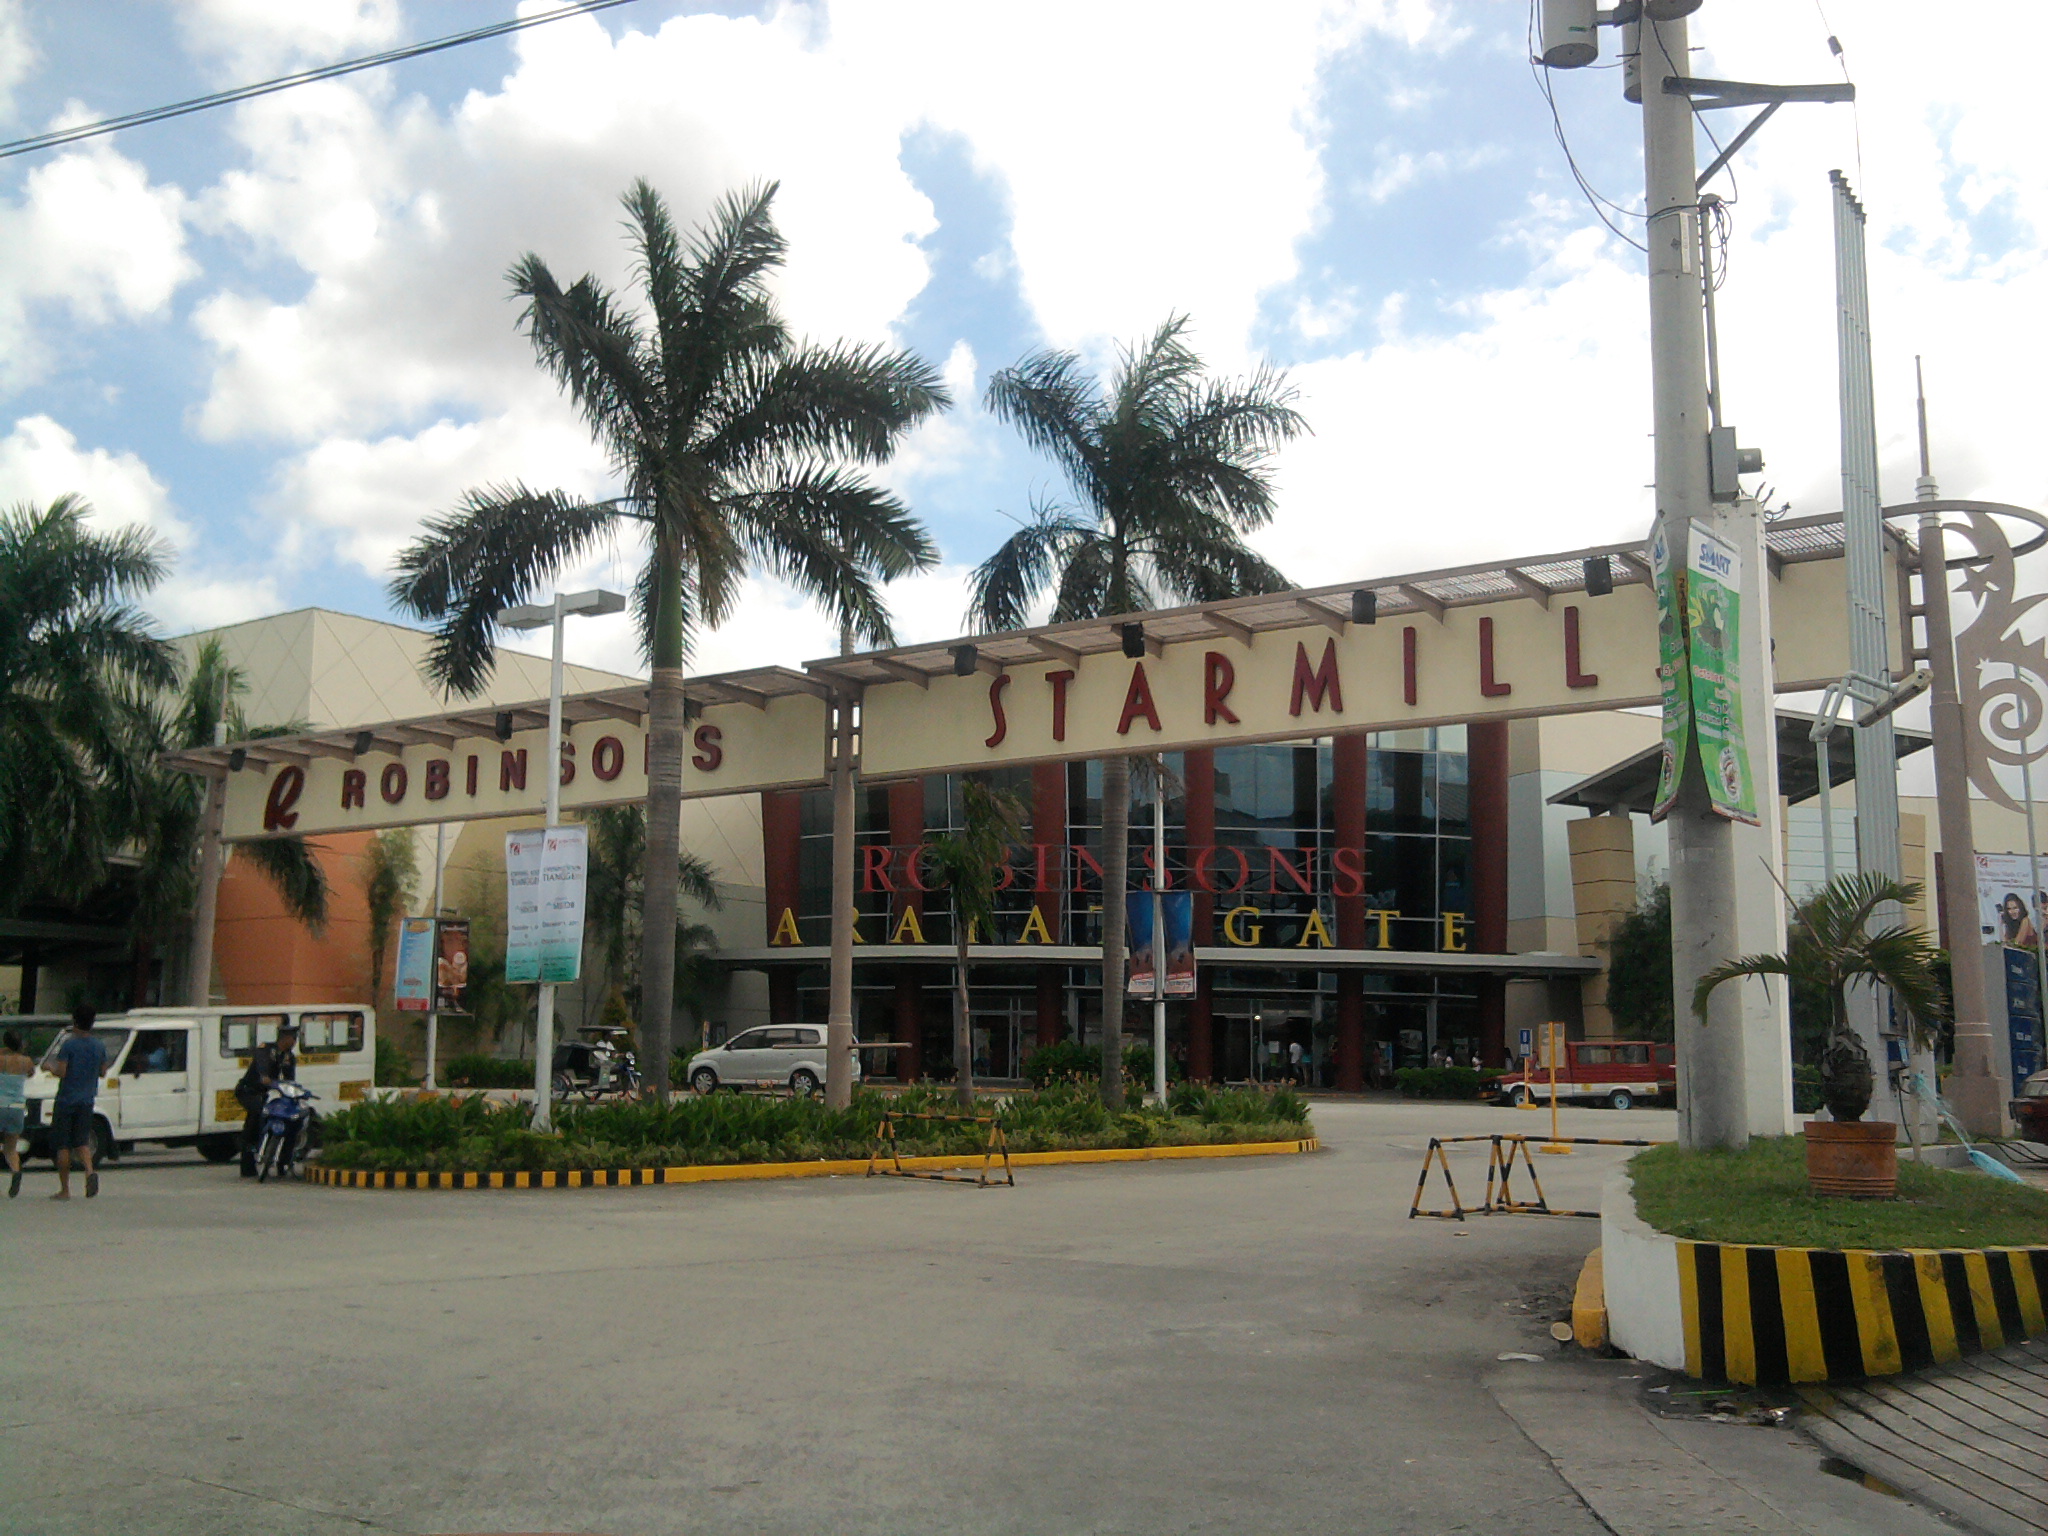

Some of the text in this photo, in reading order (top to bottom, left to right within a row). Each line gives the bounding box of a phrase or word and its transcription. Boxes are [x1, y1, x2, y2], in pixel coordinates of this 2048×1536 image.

[1699, 543, 1731, 576] SMART
[985, 606, 1663, 748] STARMILL
[340, 724, 723, 810] ROBINSOS
[770, 904, 1468, 952] ARAA GATE
